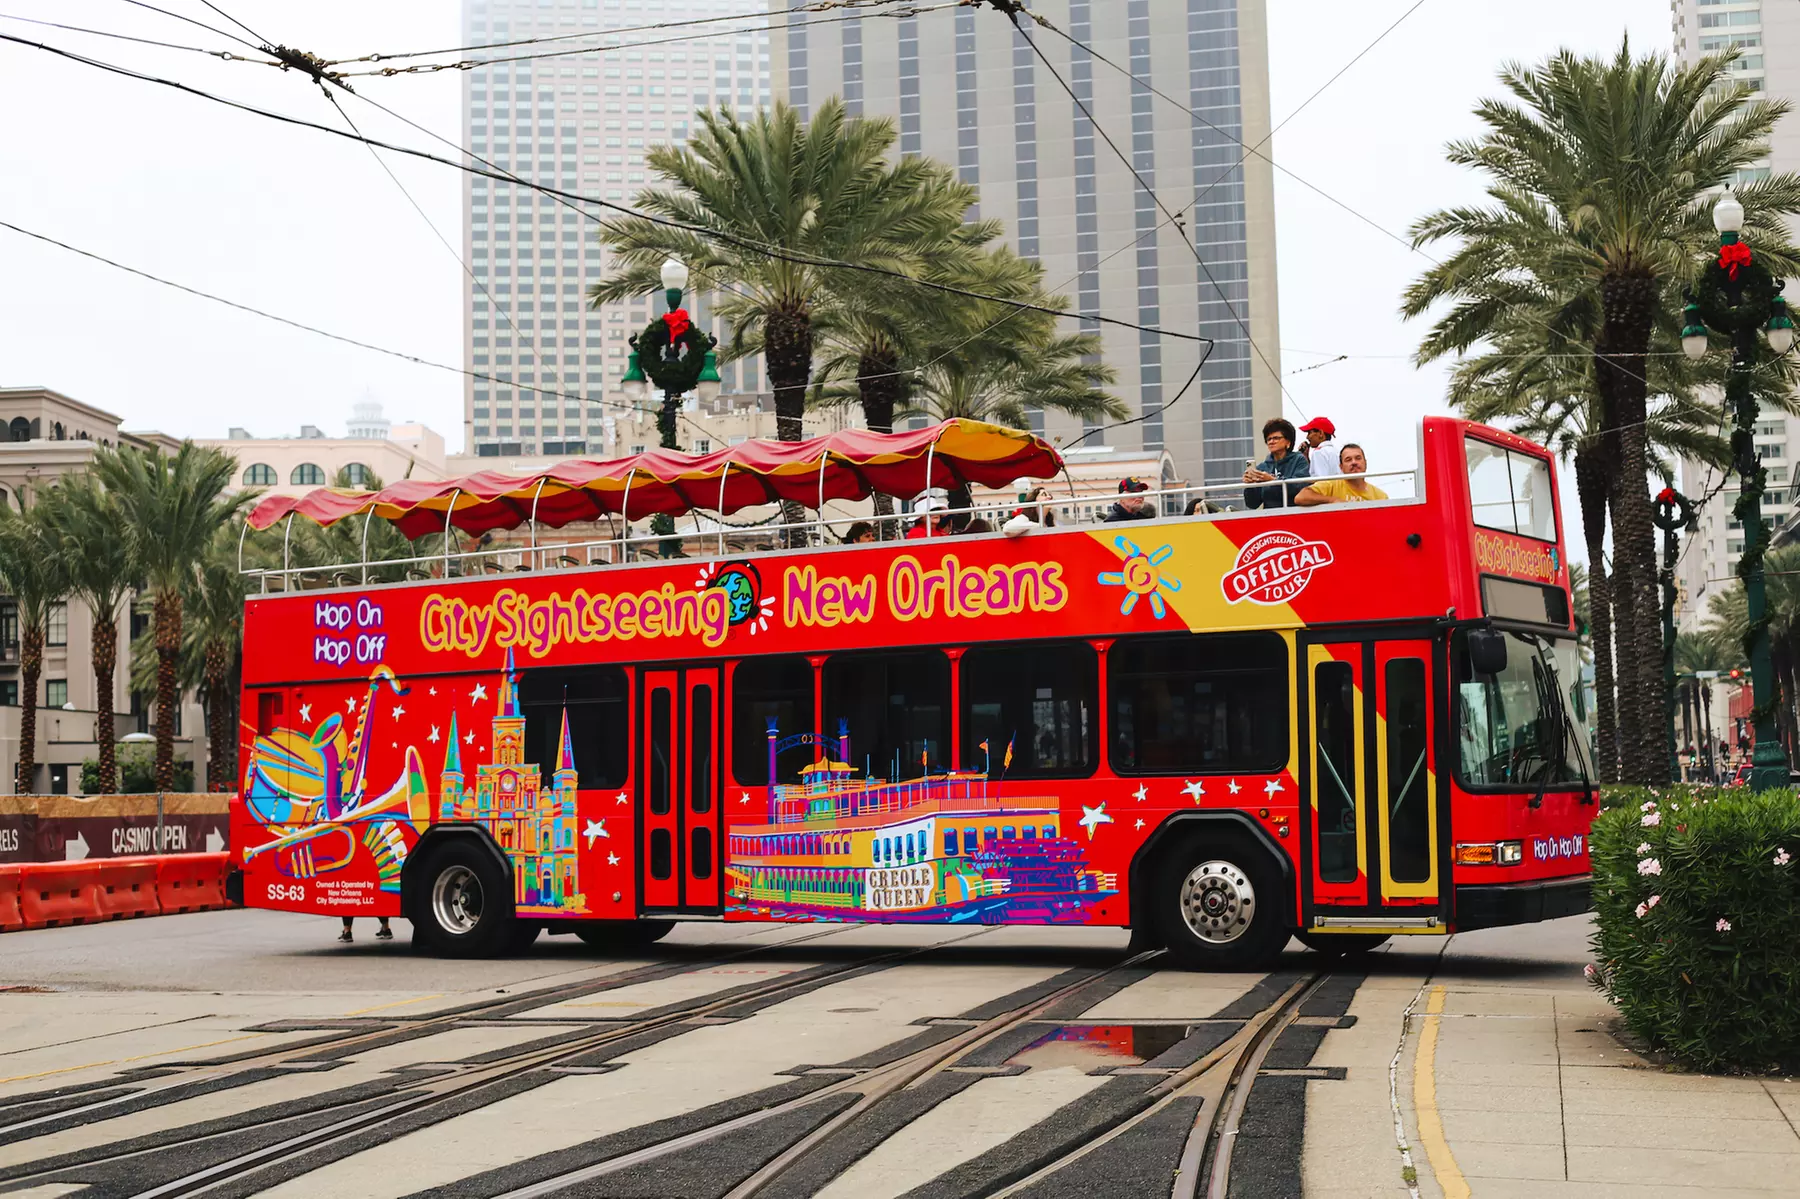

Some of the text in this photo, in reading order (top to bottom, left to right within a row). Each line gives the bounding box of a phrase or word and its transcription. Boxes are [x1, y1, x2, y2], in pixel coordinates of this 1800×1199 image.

[1242, 536, 1298, 563] CITYSIGHTSEEING
[1475, 532, 1555, 584] CitySightseeing
[1232, 546, 1326, 594] OFFICIAL
[784, 565, 877, 628] New
[887, 554, 1069, 622] Orleans
[1264, 575, 1305, 599] TOUR
[315, 598, 382, 631] Hop On
[314, 633, 386, 666] Hop Off
[112, 826, 151, 853] CASINO
[1533, 834, 1583, 861] Hop On Hop Off
[315, 880, 335, 888] Owned
[341, 880, 366, 889] Operated
[366, 881, 374, 890] by
[869, 868, 930, 888] CREOLE
[267, 884, 305, 901] SS-63
[316, 896, 328, 906] City
[362, 897, 375, 905] LLC
[327, 889, 362, 897] New Orleans
[872, 888, 924, 909] QUEEN
